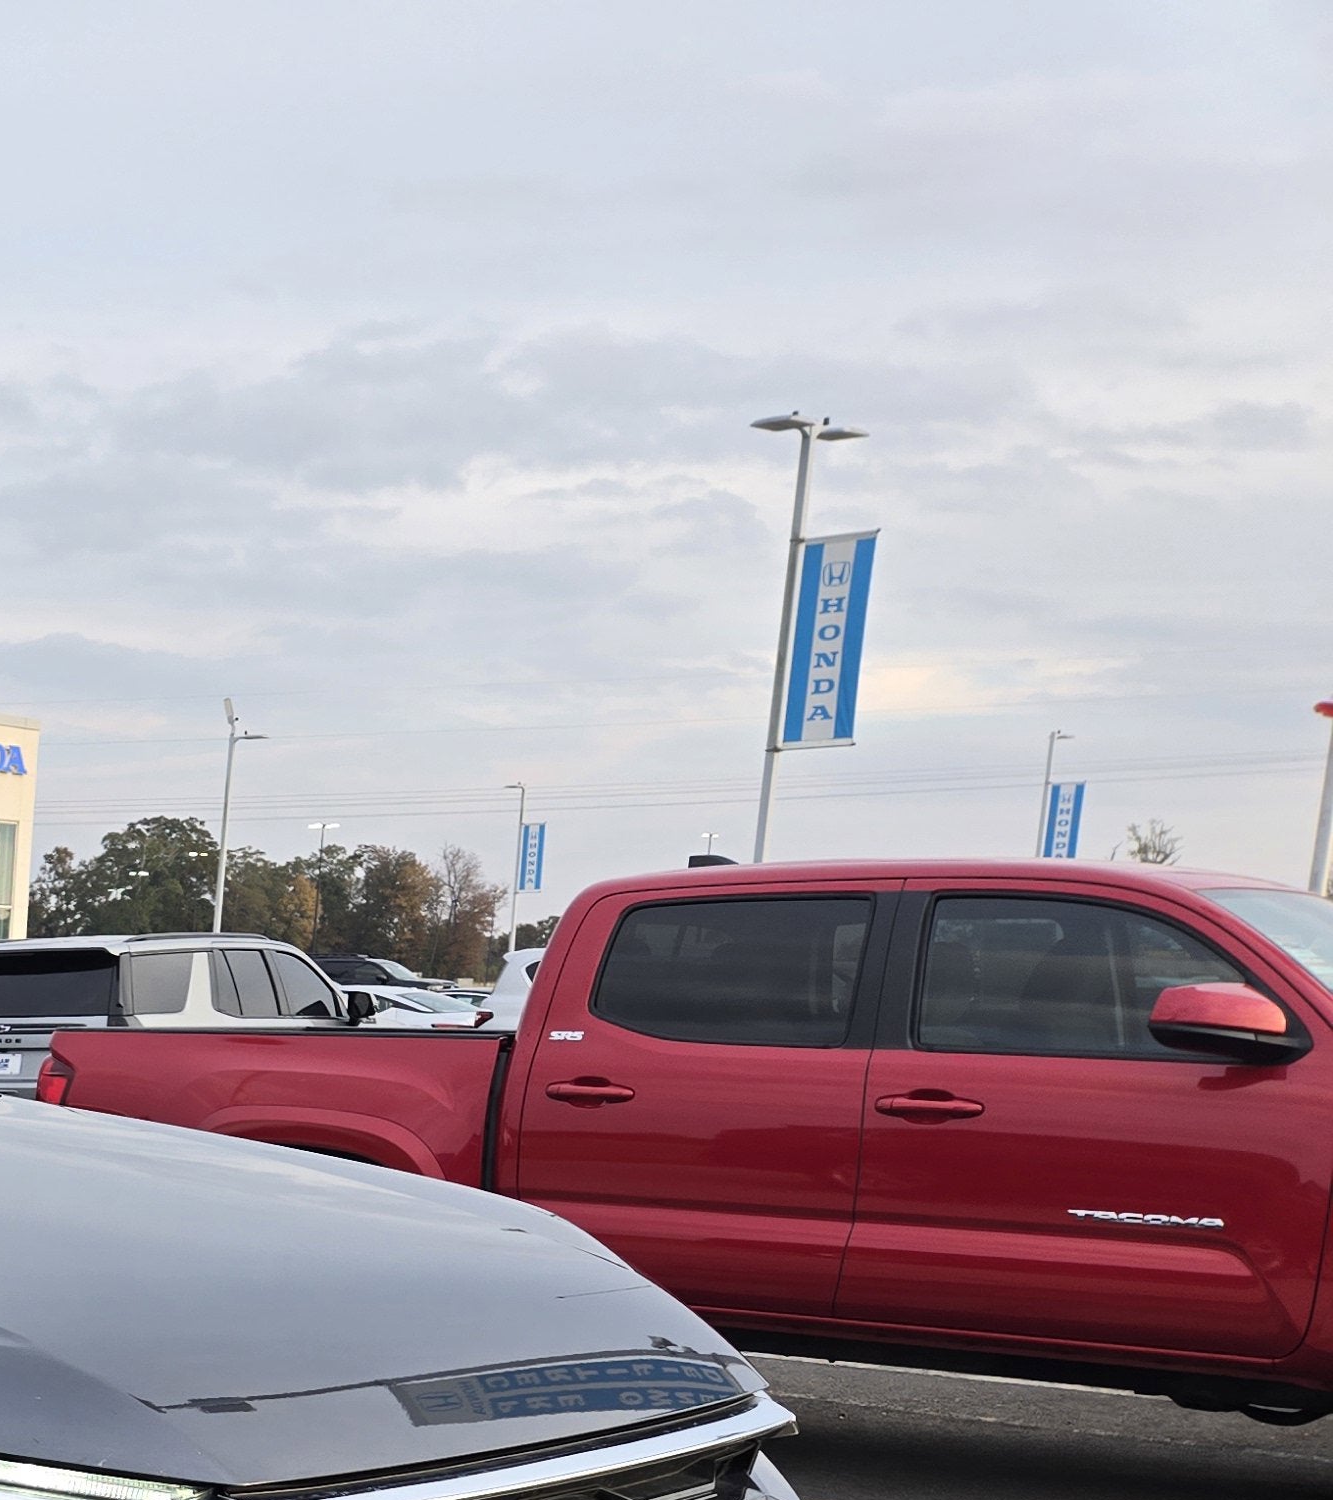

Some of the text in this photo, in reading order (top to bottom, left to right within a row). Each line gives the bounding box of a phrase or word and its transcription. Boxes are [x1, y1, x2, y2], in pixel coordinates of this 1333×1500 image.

[807, 597, 846, 721] HONDA
[549, 1031, 584, 1040] SR5
[1067, 1209, 1224, 1228] TACOMA
